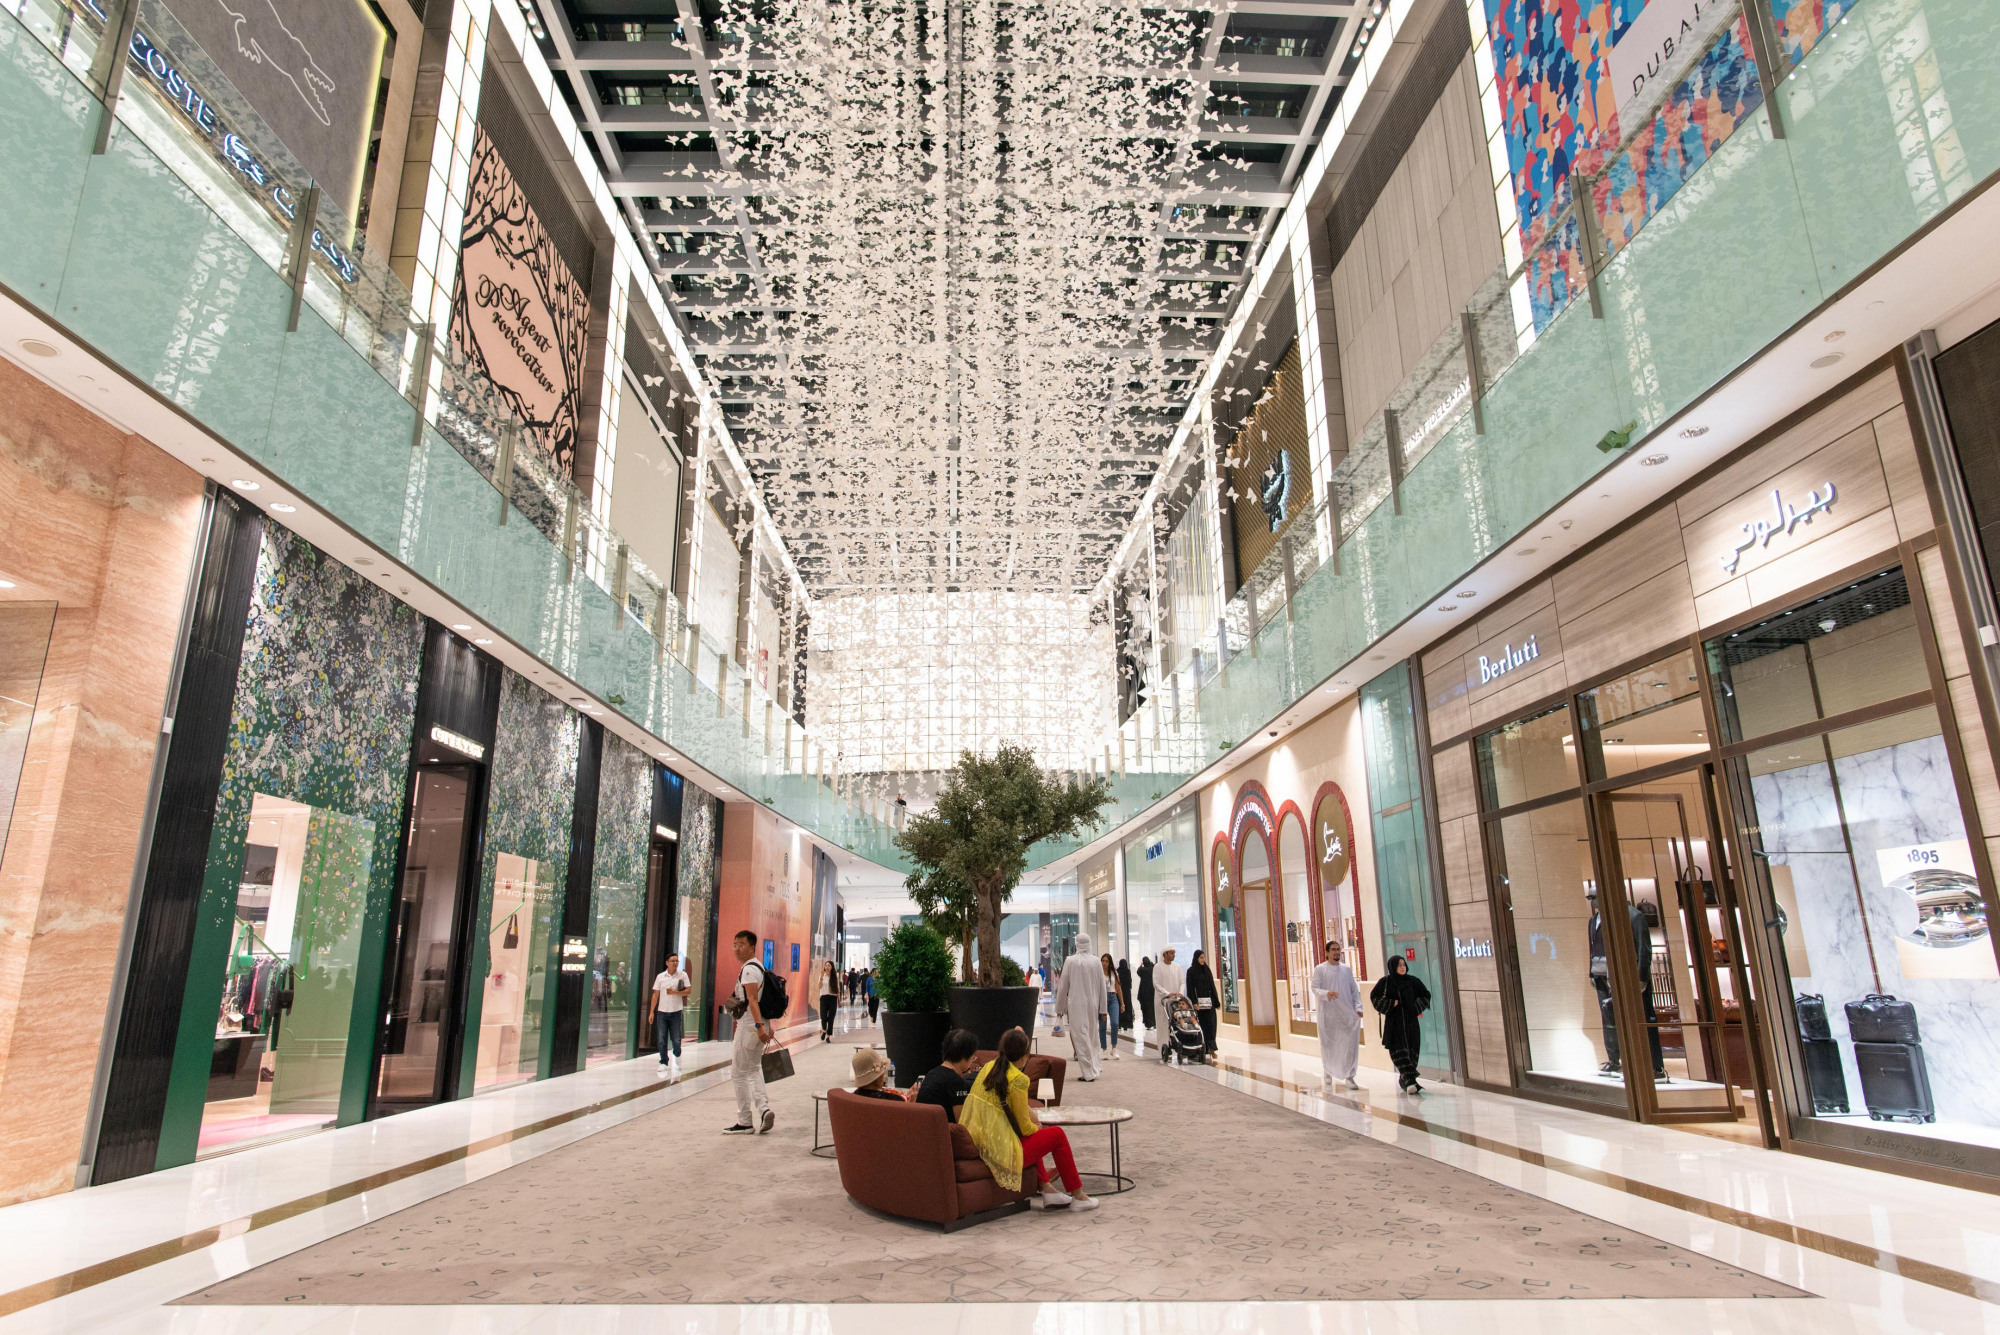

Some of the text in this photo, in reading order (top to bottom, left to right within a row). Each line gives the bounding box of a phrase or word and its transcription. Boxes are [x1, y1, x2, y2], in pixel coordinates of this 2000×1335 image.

[1632, 3, 1700, 98] DUBAI
[500, 283, 552, 353] Agent
[1718, 482, 1837, 576] بيرلوتي
[1479, 634, 1540, 685] Berluti
[1907, 849, 1939, 864] 1895
[1453, 937, 1493, 958] Berluti
